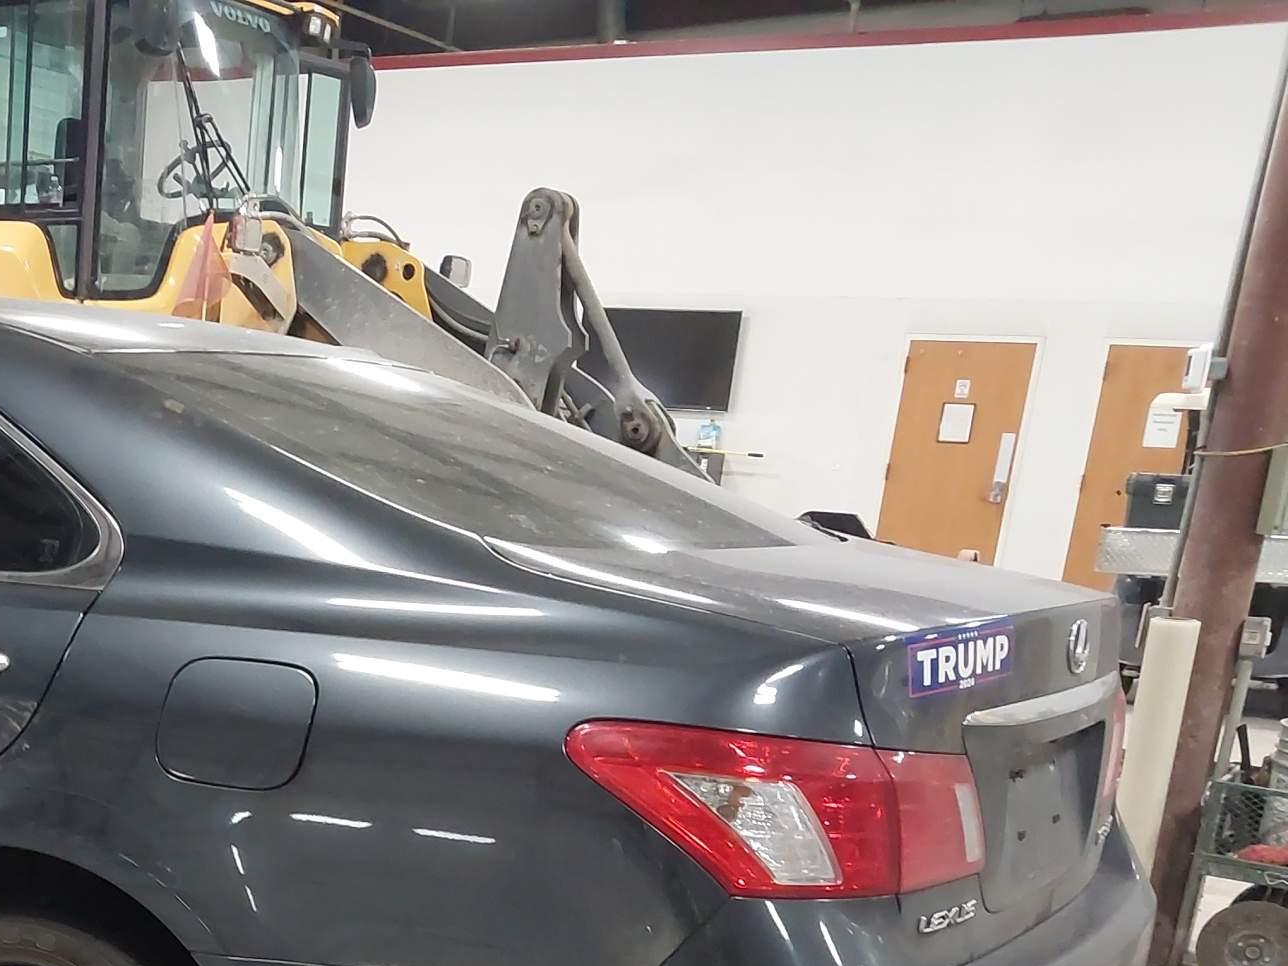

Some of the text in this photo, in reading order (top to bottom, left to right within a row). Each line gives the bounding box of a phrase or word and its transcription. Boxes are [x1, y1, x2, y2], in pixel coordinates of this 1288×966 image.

[210, 1, 271, 33] VOLVO
[916, 635, 1009, 686] TRUMP
[918, 899, 977, 933] LEXUS
